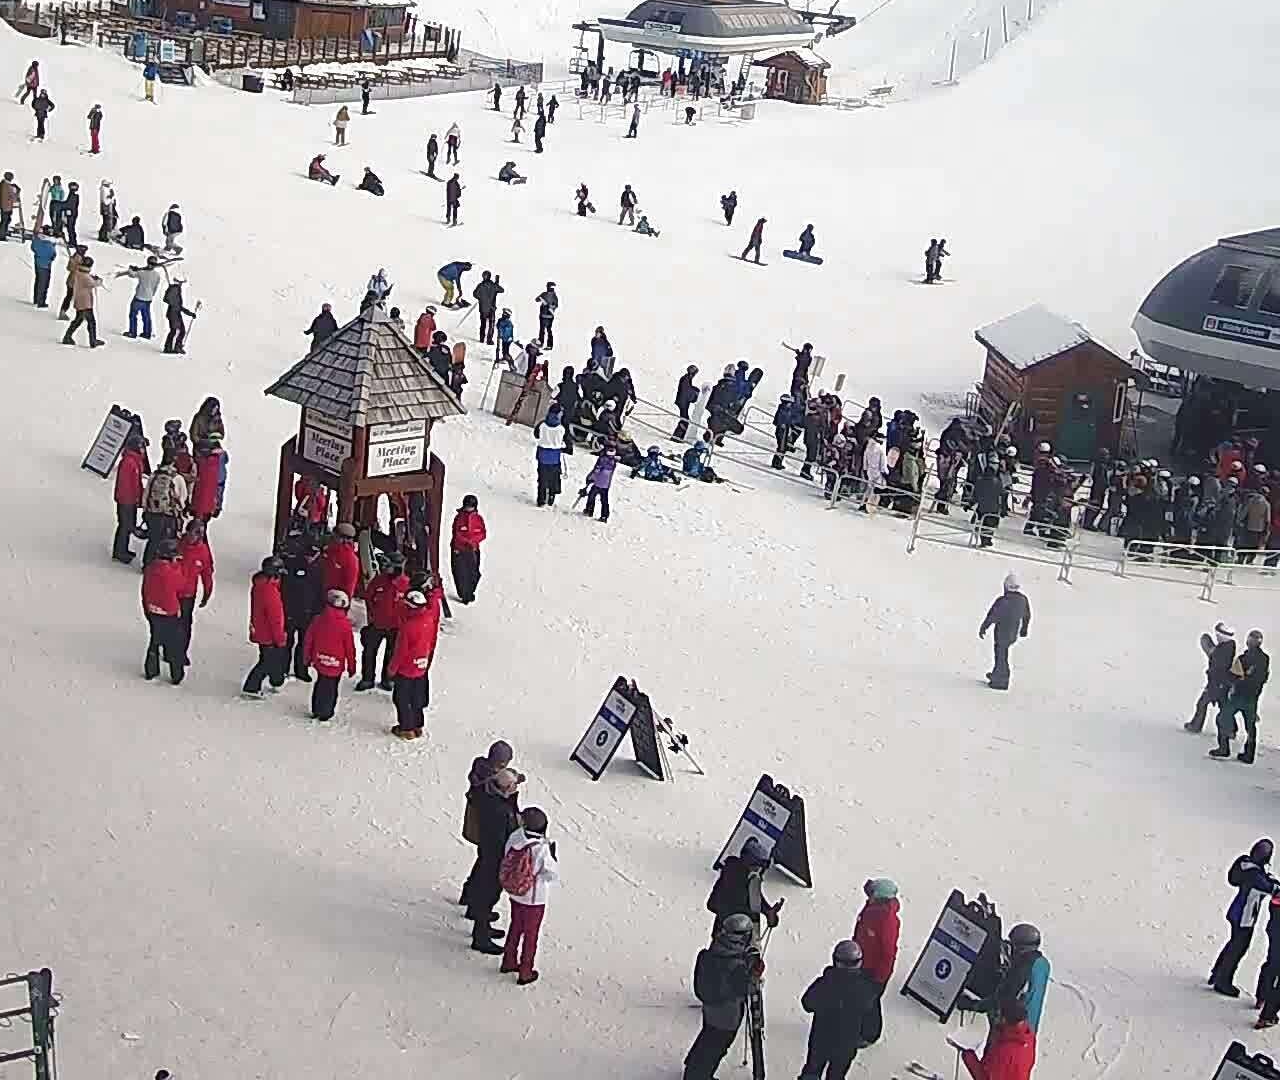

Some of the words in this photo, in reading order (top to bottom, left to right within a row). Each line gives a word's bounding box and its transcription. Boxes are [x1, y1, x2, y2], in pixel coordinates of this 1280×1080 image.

[315, 446, 340, 463] Place
[377, 444, 417, 456] Meeting
[381, 455, 411, 469] Place
